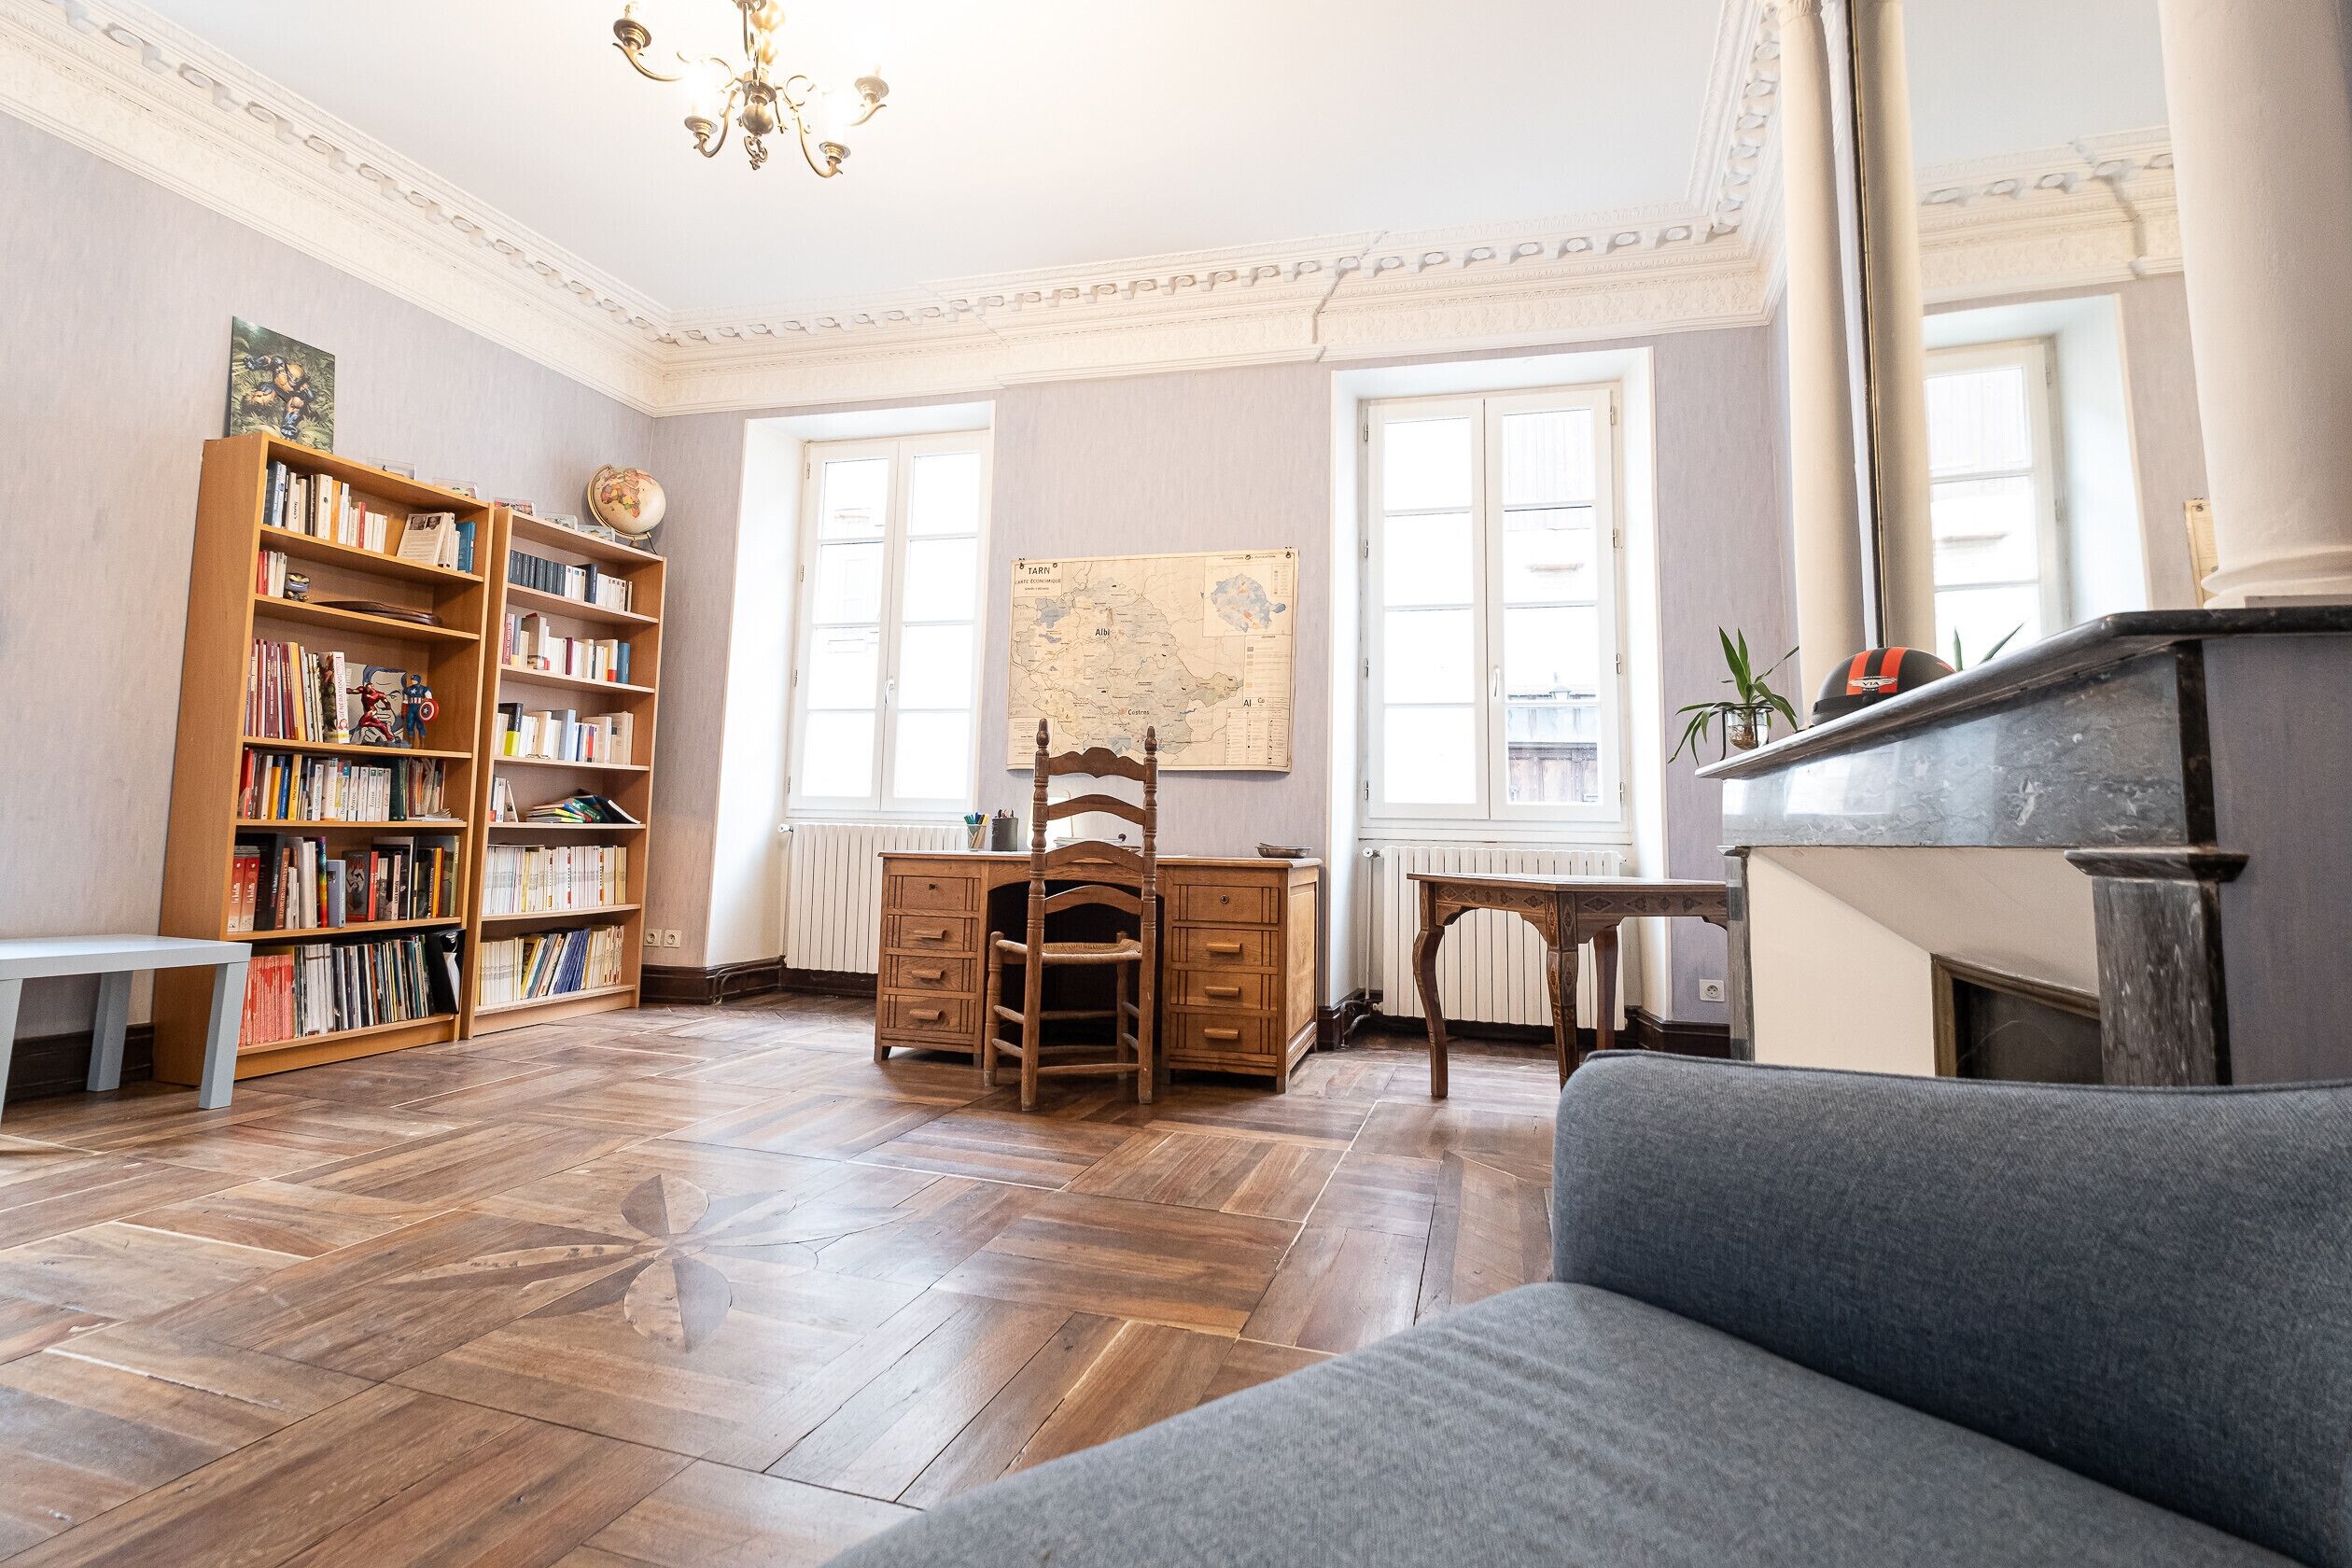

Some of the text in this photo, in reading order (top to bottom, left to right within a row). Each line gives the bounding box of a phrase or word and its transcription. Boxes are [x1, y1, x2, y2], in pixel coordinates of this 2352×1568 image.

[1028, 567, 1050, 575] TARN
[1095, 628, 1111, 637] Albi
[1243, 699, 1252, 707] Al
